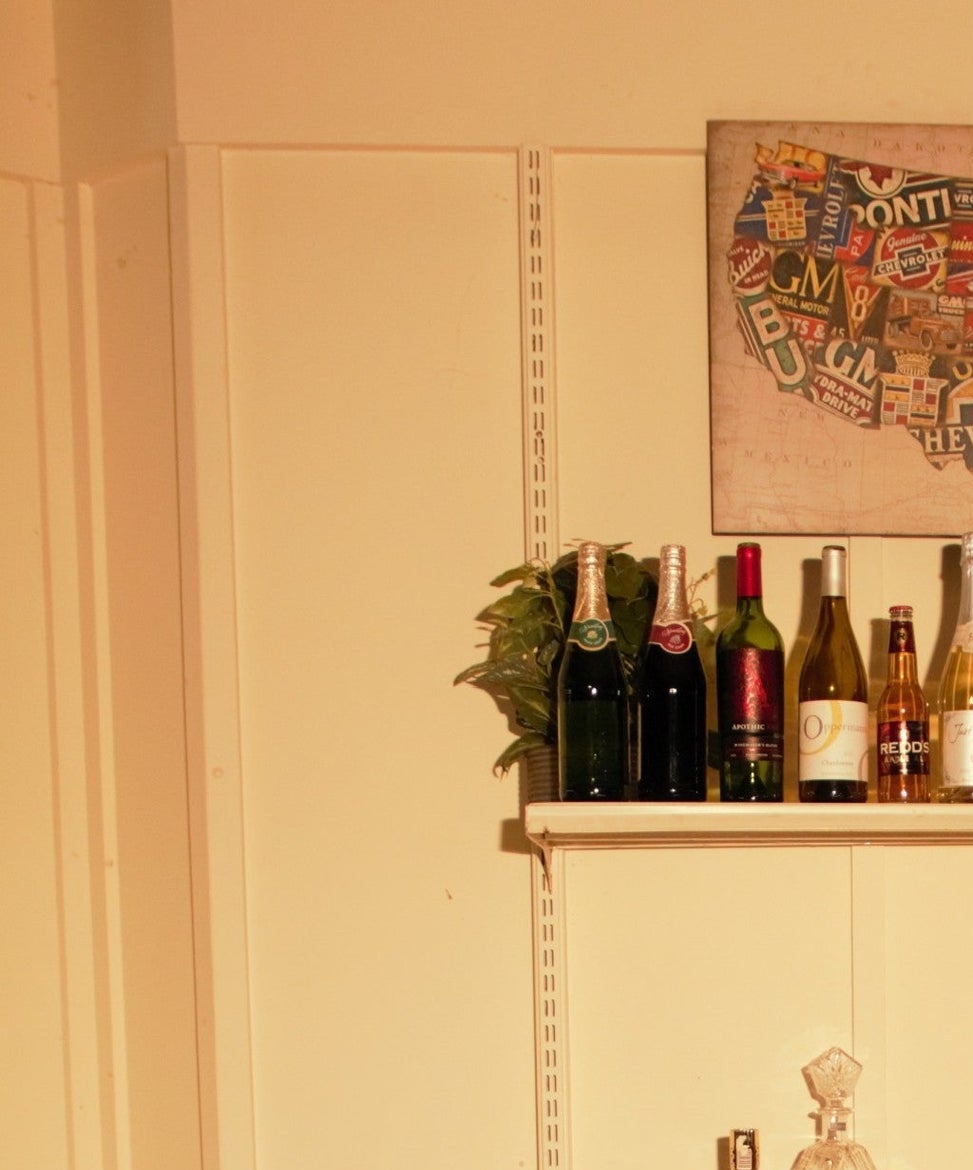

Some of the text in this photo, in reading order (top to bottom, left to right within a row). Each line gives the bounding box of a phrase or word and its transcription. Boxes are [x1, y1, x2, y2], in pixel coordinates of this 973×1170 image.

[877, 248, 945, 274] CHEVROLET
[768, 247, 840, 304] GM
[822, 391, 861, 419] DRIVE
[731, 723, 766, 731] APOTHIC
